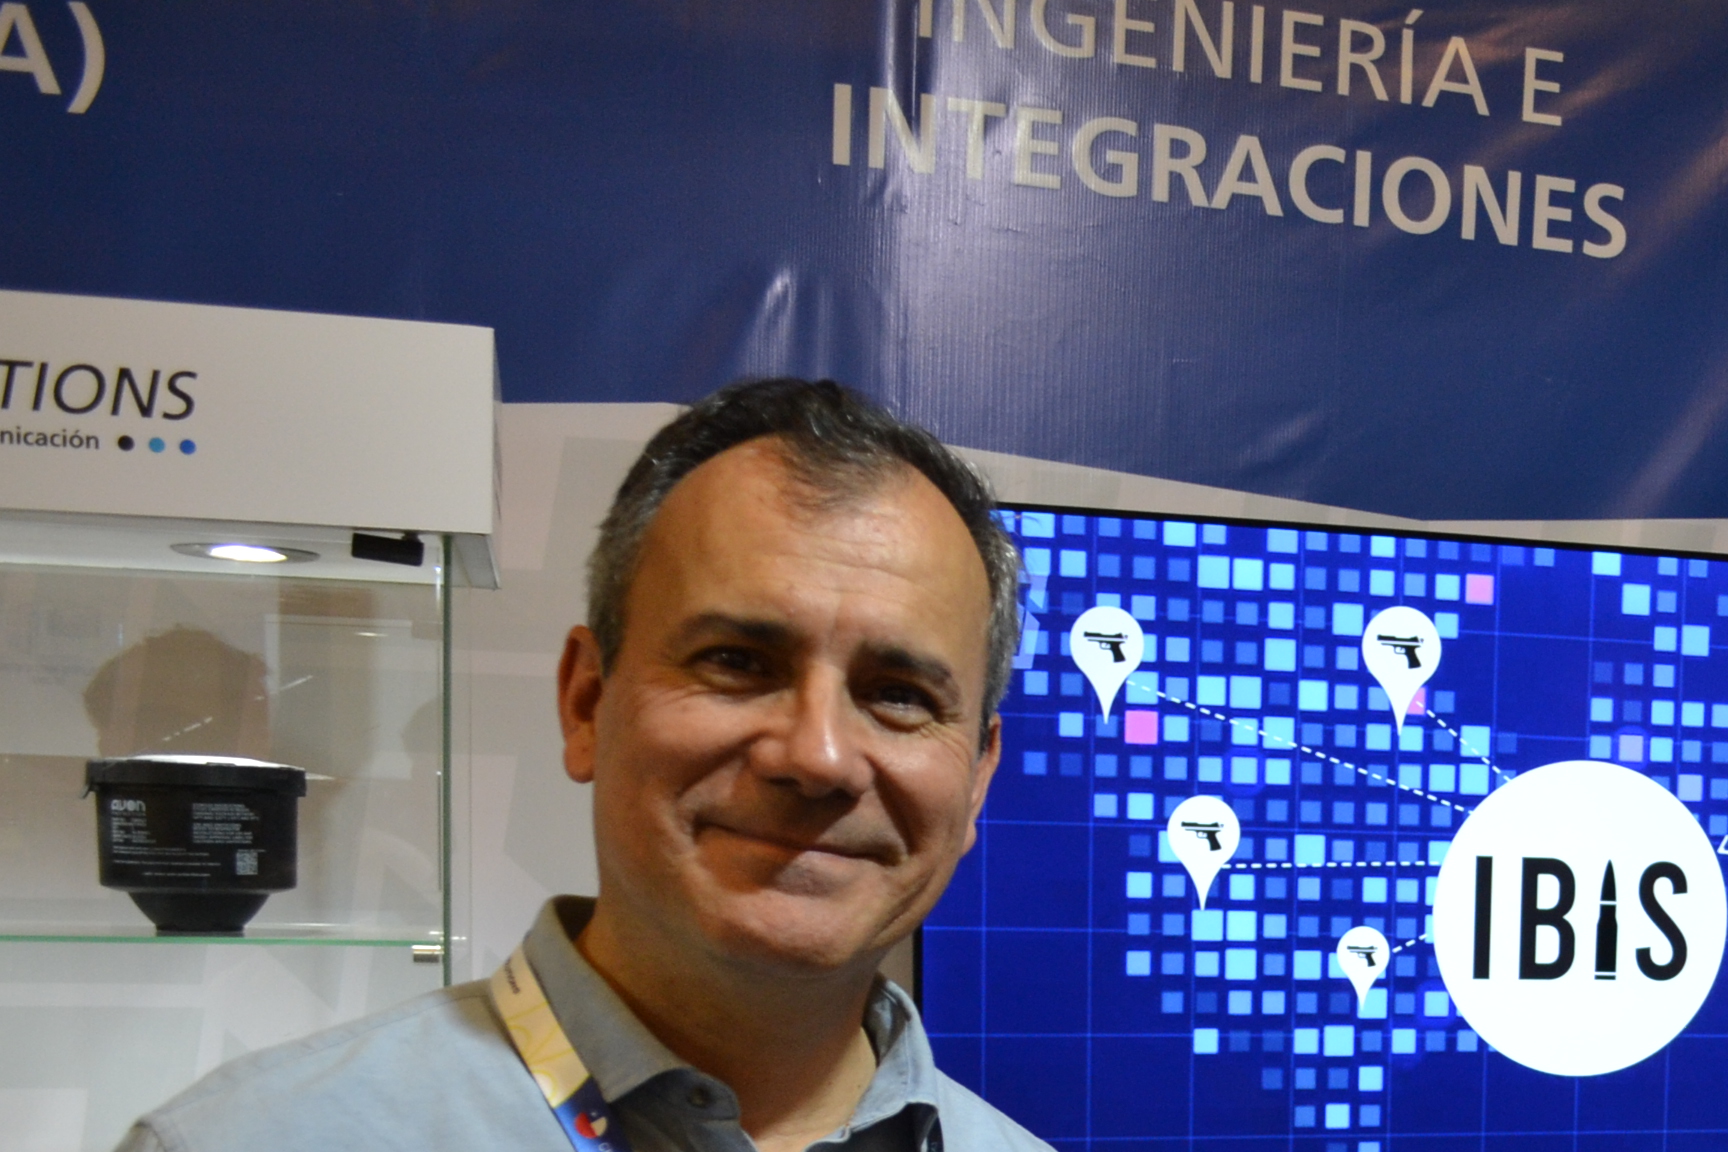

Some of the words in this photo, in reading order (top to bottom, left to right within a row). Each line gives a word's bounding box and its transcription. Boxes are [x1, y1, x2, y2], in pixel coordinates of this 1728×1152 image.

[1522, 47, 1565, 127] E
[832, 82, 1628, 259] INTEGRACIONES
[0, 359, 198, 420] TIONS
[1472, 855, 1689, 982] IBIS
